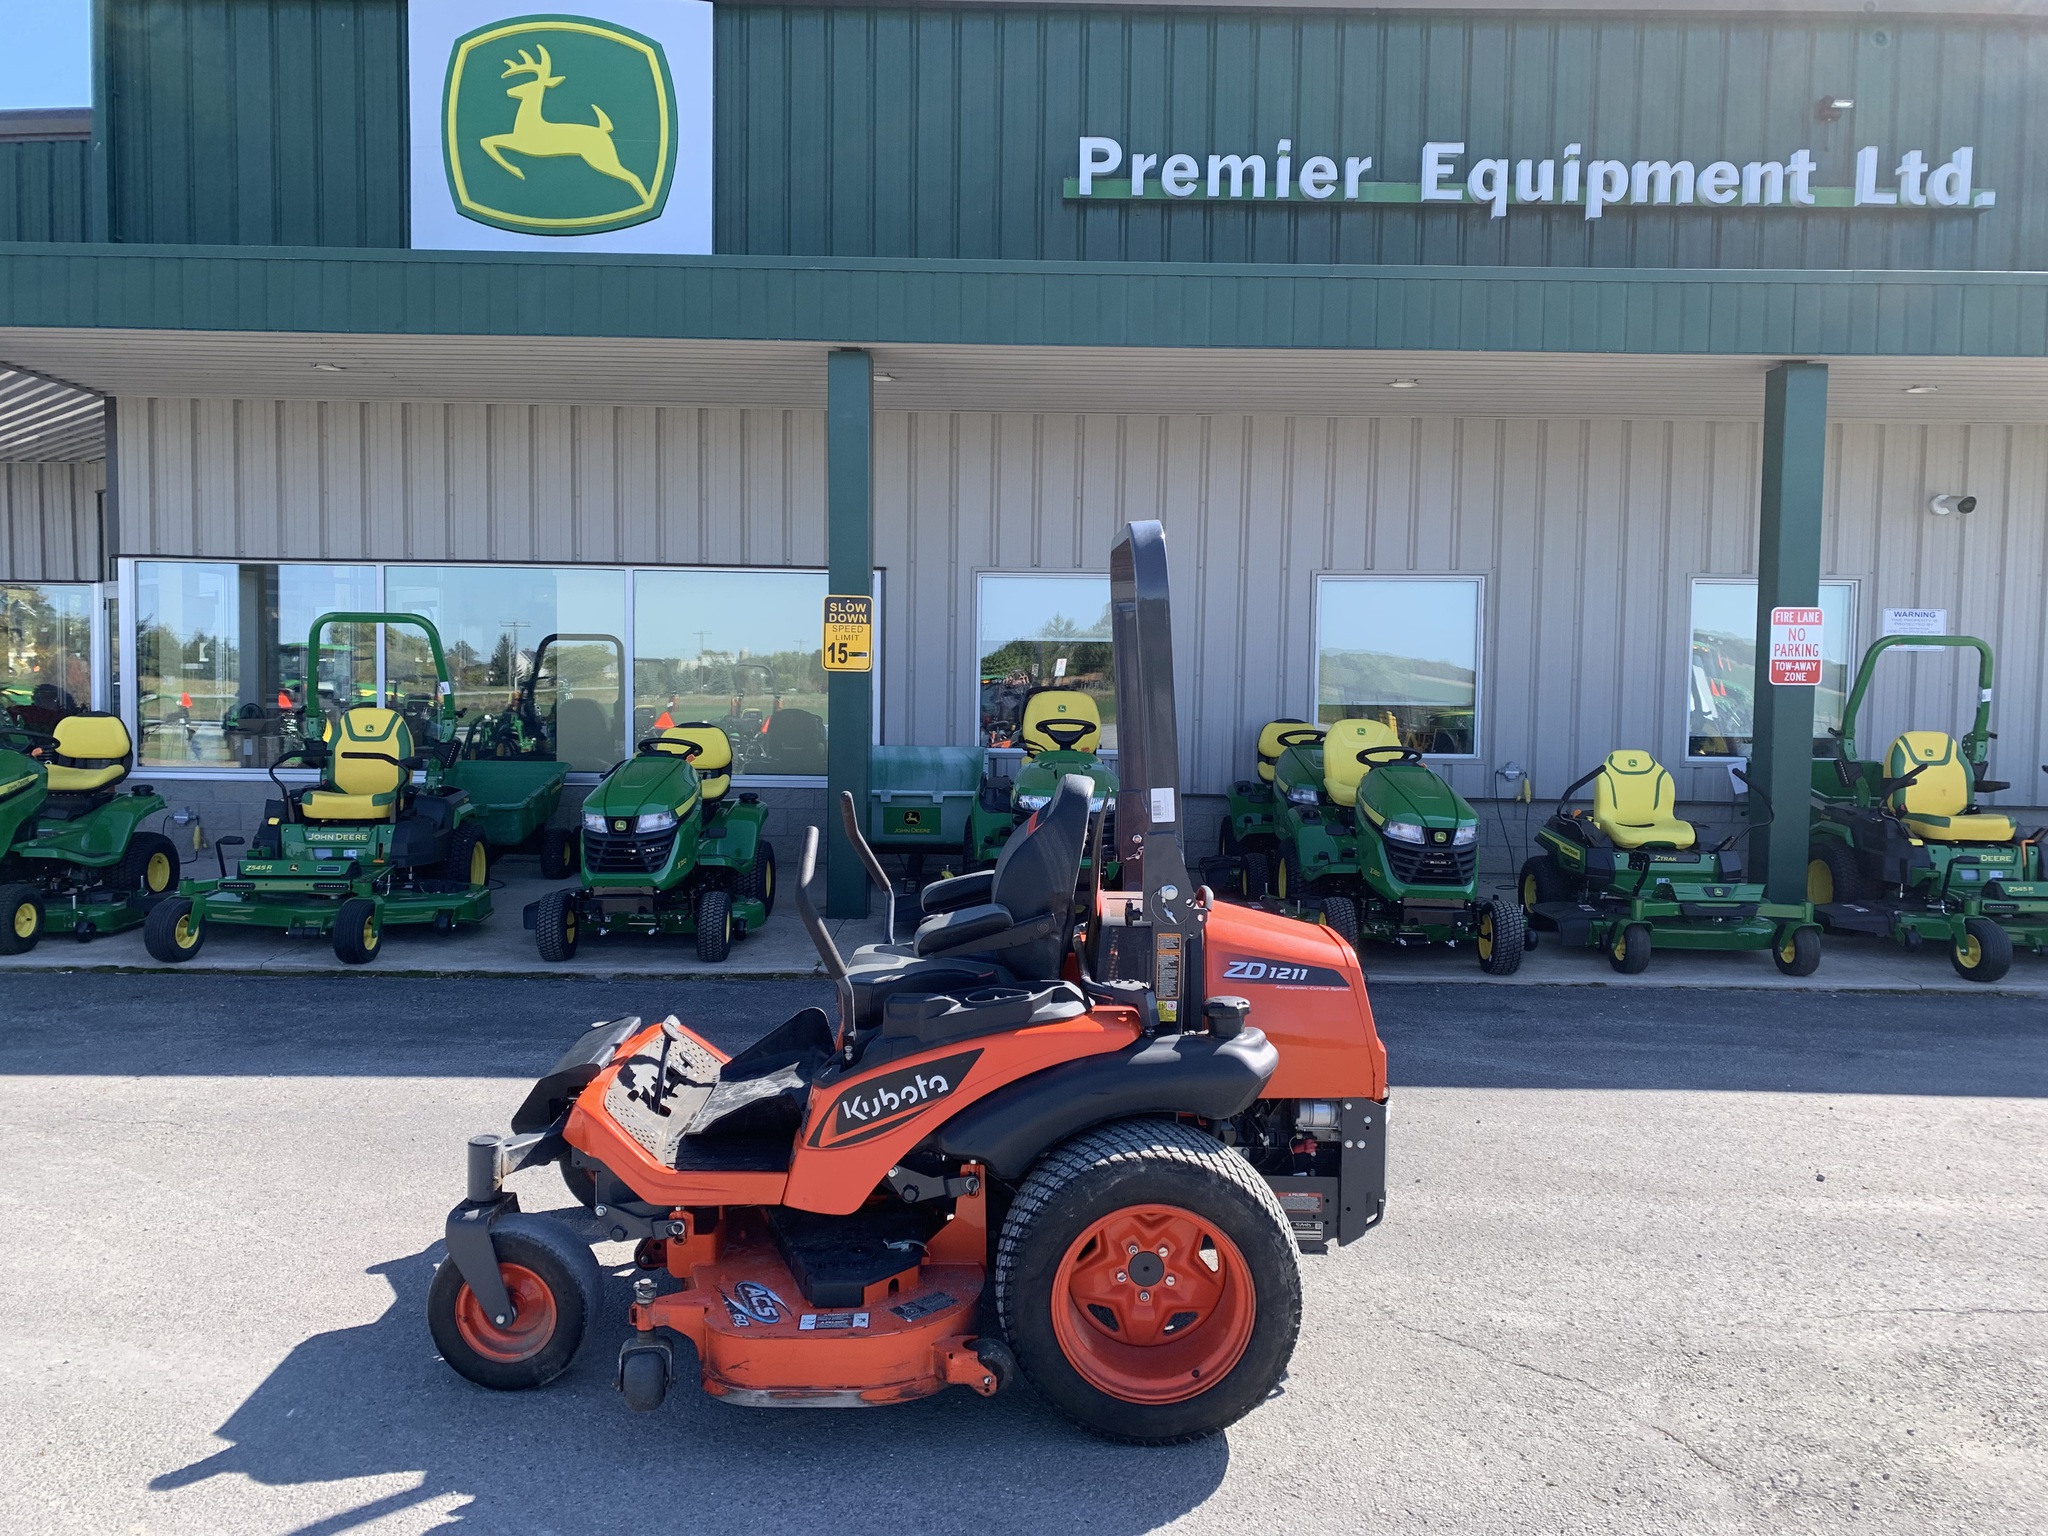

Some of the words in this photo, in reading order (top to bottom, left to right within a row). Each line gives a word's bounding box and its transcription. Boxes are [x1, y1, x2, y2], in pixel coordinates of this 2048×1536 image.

[1078, 136, 1373, 201] Premier
[1421, 141, 1817, 221] Equipment
[1854, 145, 1996, 208] Ltd.
[829, 602, 867, 613] SLOW
[828, 613, 867, 623] DOWN
[1775, 611, 1795, 623] FIRE
[1797, 611, 1820, 623] LANE
[832, 624, 864, 633] SPEED
[1788, 627, 1806, 642] NO
[828, 642, 848, 664] 15
[1774, 643, 1819, 657] PARKING
[1775, 661, 1817, 671] TOW-AWAY
[1784, 672, 1807, 682] ZONE
[308, 833, 334, 841] JOHN
[335, 833, 368, 841] DEERE
[1981, 854, 2012, 862] DEERE
[841, 1074, 949, 1121] Kubota
[744, 1287, 779, 1317] ACS
